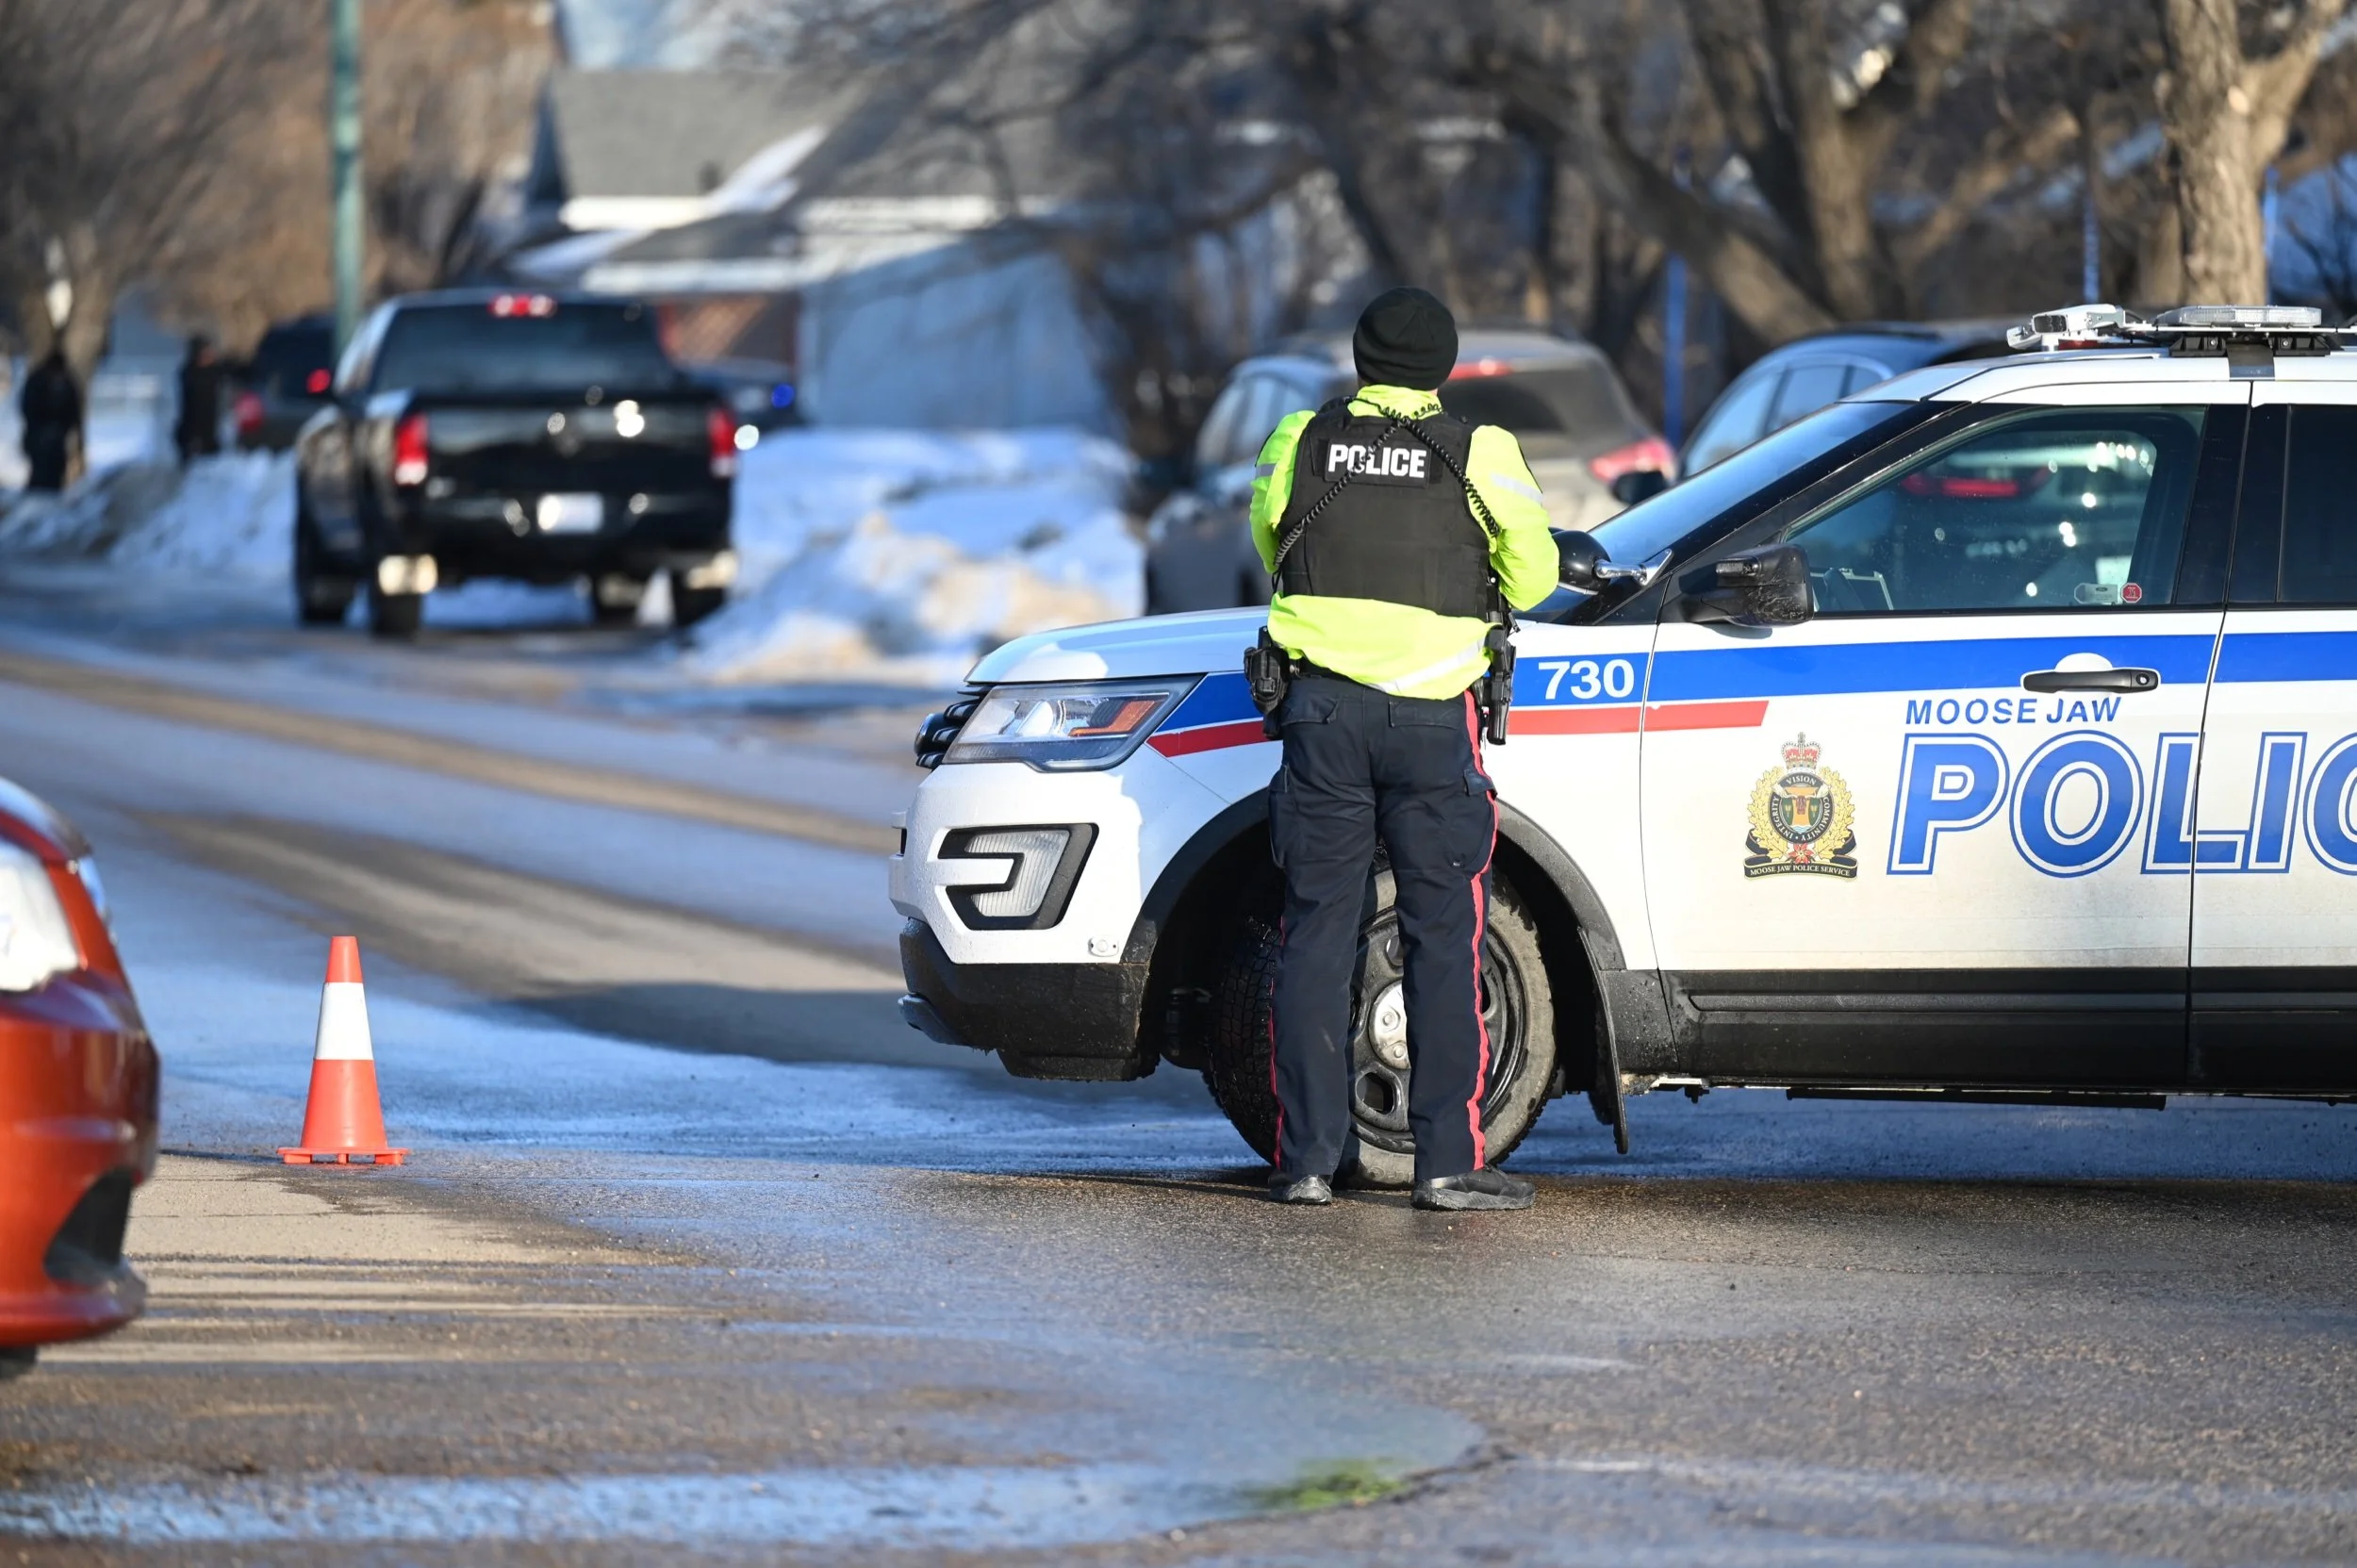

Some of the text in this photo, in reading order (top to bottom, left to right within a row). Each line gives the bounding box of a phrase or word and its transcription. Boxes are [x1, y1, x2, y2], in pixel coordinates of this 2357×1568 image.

[1327, 444, 1427, 478] POLICE
[1538, 659, 1635, 700] 730
[1904, 696, 2122, 725] MOOSE JAW
[1786, 775, 1817, 785] VISION
[1772, 795, 1793, 840] INTEGRITY
[1801, 797, 1830, 841] COMMUNITY
[1750, 866, 1777, 876] MOOSE
[1777, 865, 1791, 873] JAW
[1821, 866, 1851, 877] SERVICE
